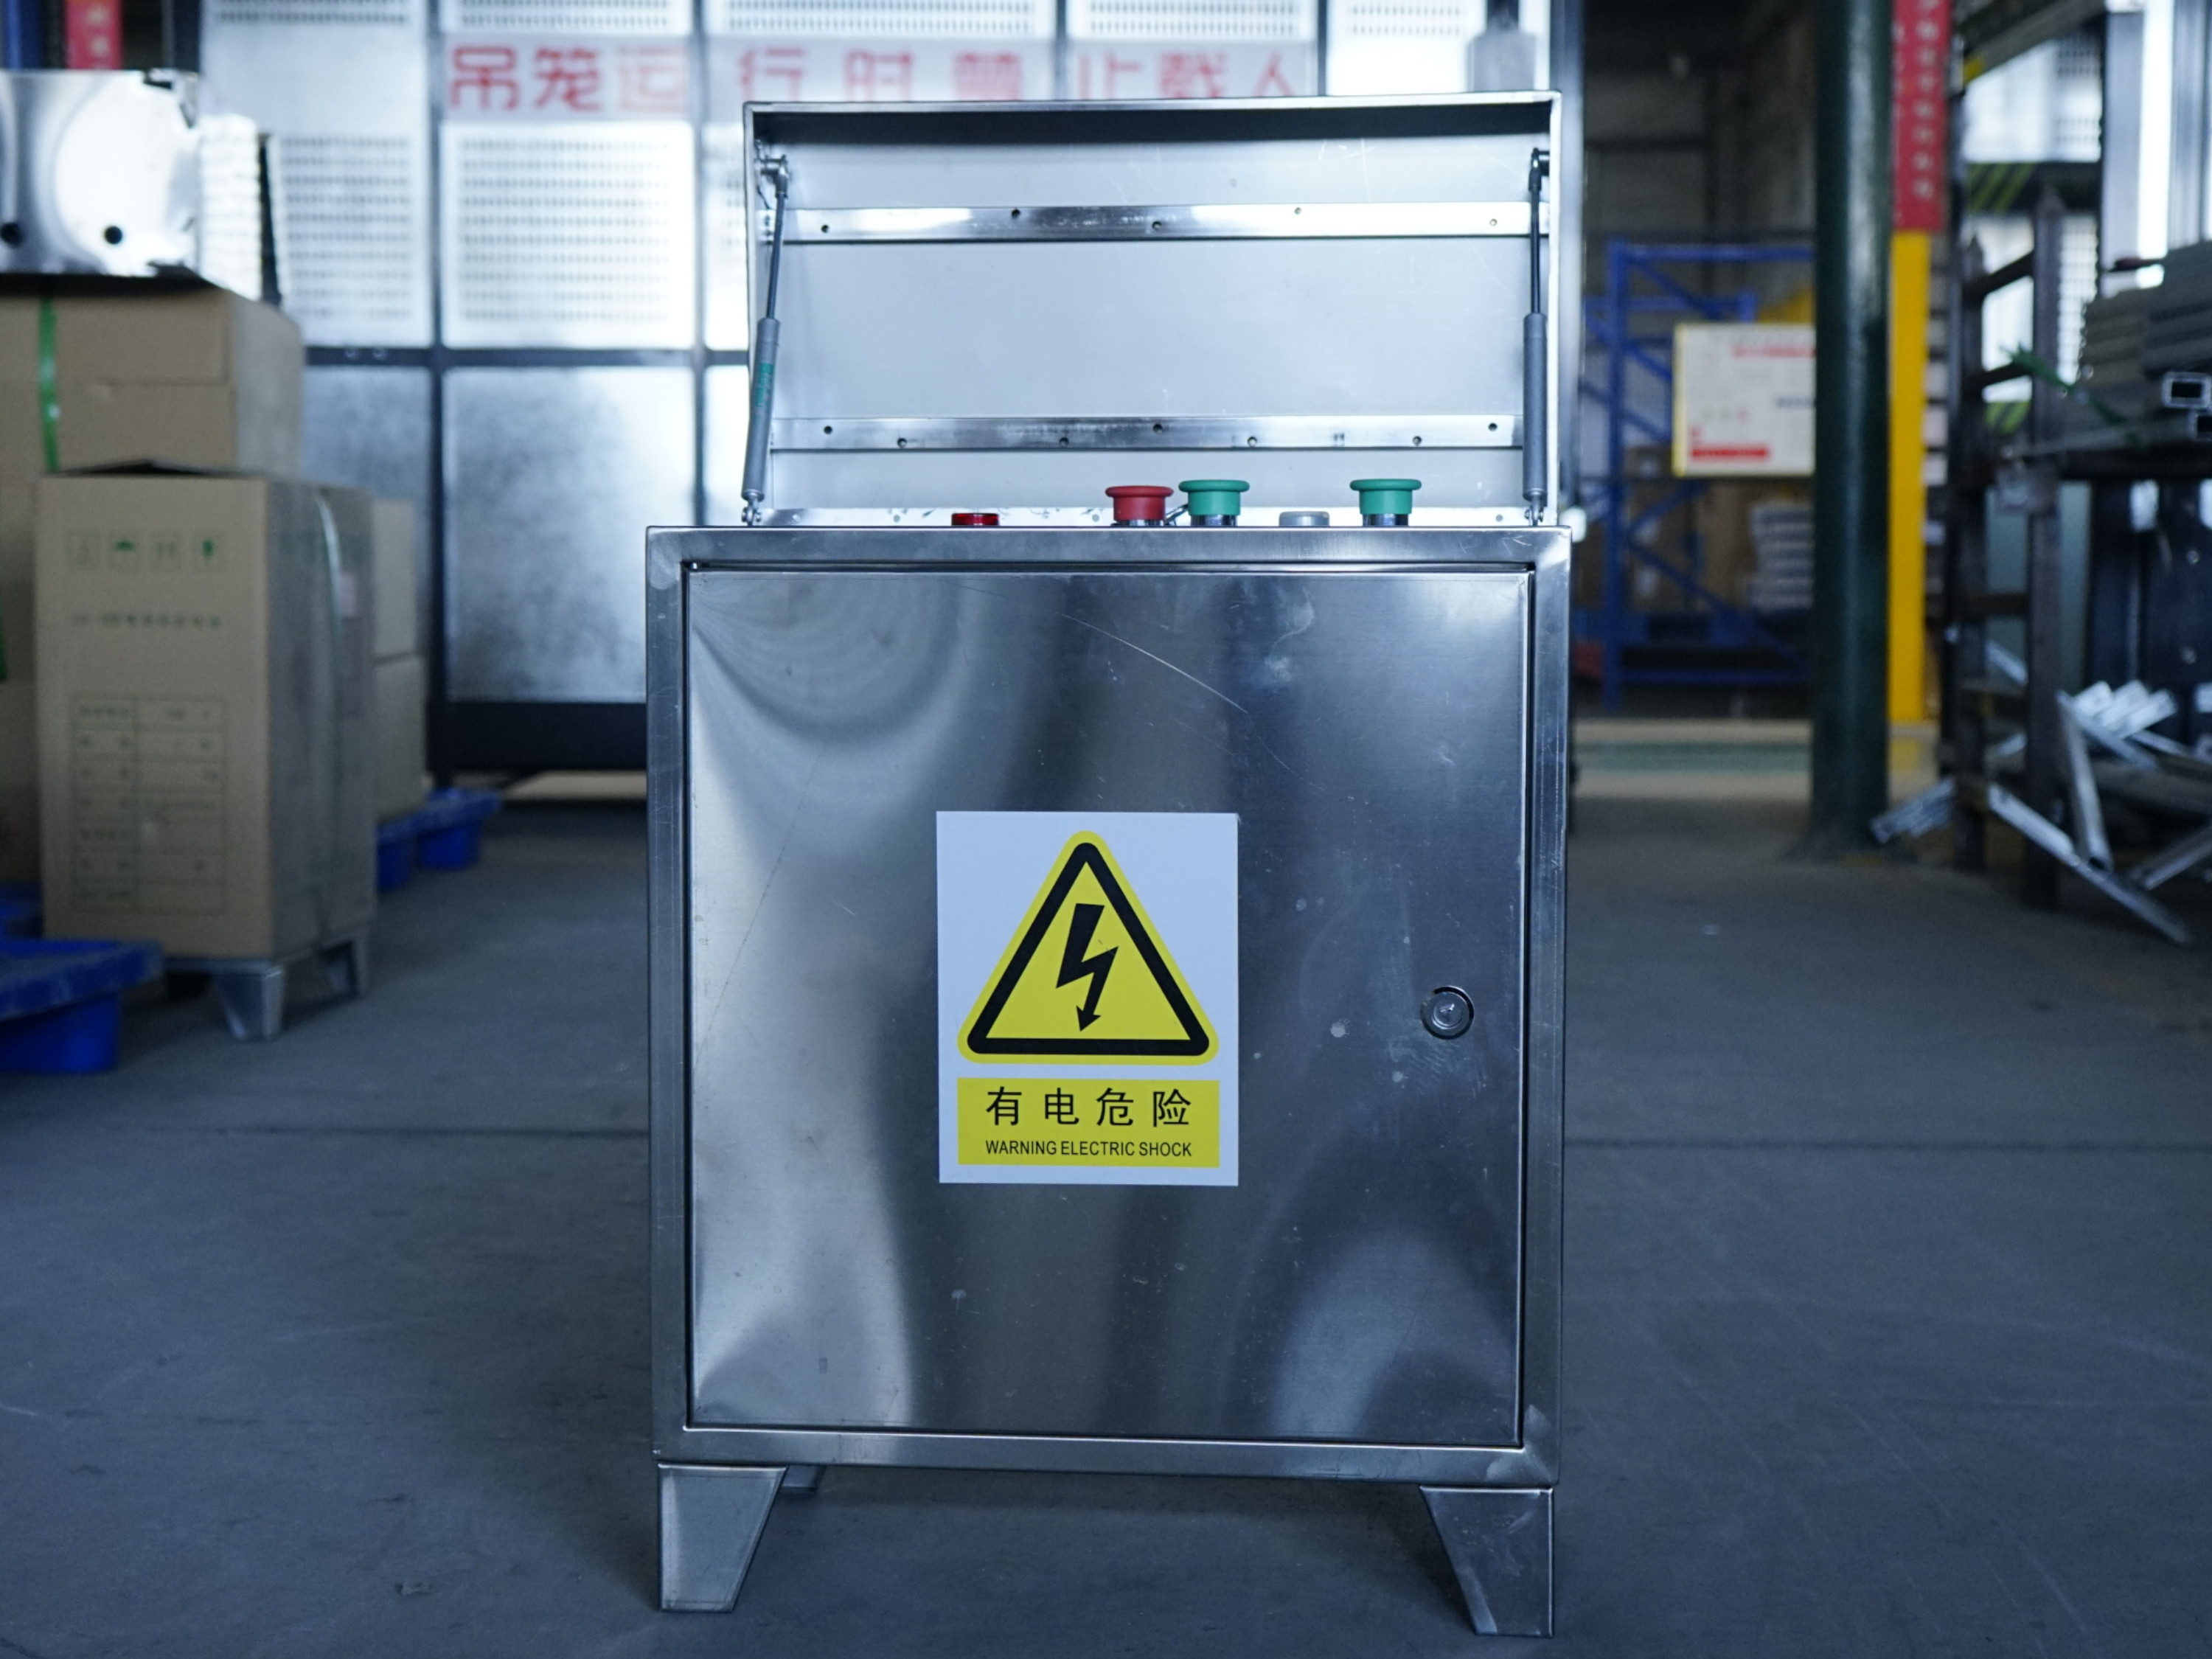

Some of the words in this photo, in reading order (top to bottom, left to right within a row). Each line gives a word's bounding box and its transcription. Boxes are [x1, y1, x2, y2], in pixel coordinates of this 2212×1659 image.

[985, 1085, 1192, 1127] 有电危险
[985, 1139, 1057, 1155] WARNING
[1060, 1141, 1135, 1156] ELECTRIC
[1138, 1141, 1192, 1157] SHOCK
